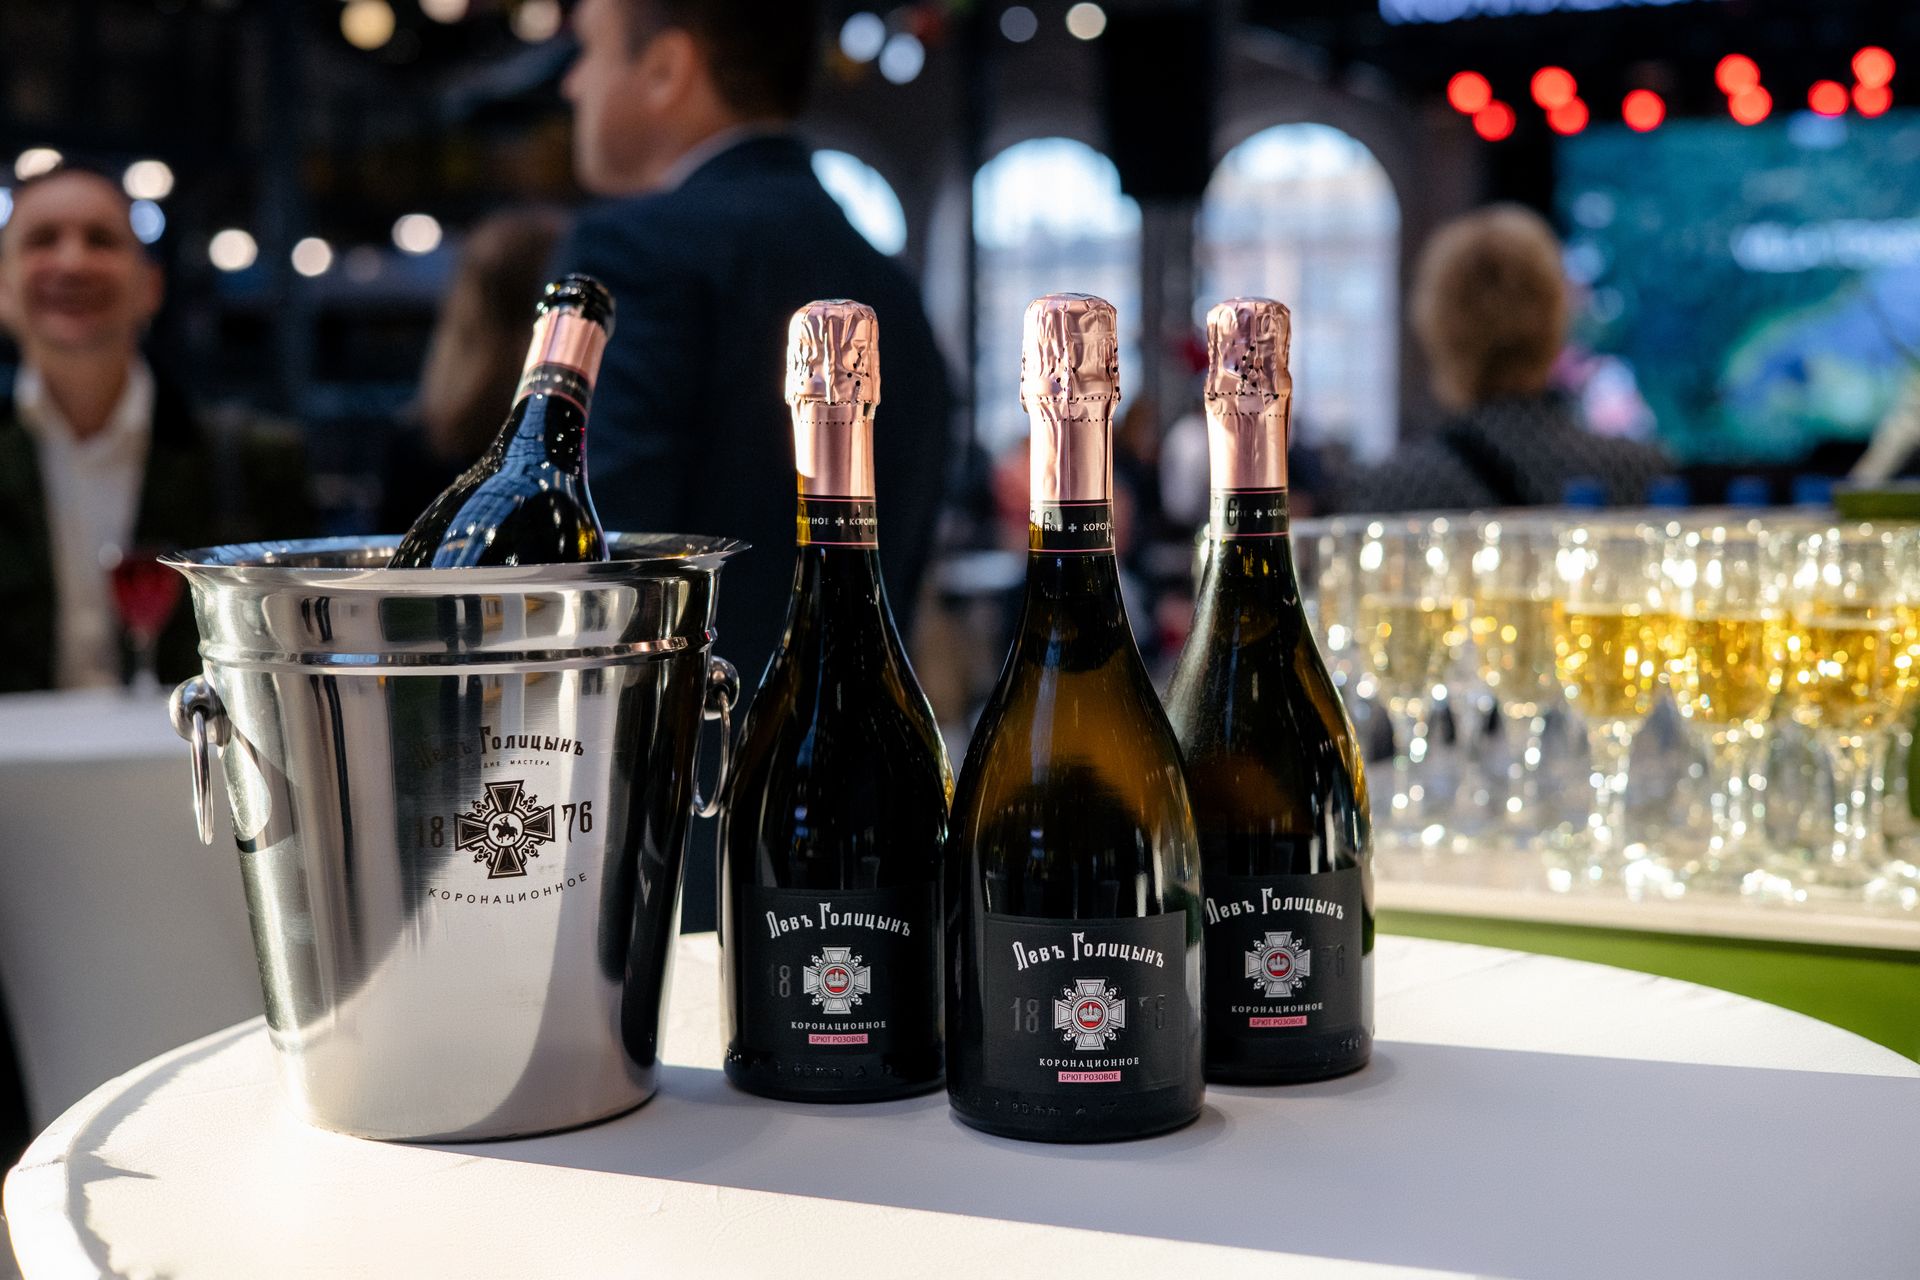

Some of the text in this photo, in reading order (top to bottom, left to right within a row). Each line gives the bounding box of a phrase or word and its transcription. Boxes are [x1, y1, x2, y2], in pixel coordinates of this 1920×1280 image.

[479, 726, 585, 756] Голицынъ
[510, 759, 550, 767] МАСТЕРА
[562, 800, 593, 843] 76
[428, 872, 587, 905] КОРОНАЦИОННОЕ
[1206, 887, 1344, 925] Левъ Голицынъ
[765, 902, 911, 939] Левъ Голицынъ
[1012, 931, 1164, 971] Левъ Голицынъ
[1010, 997, 1040, 1034] 18
[1231, 1002, 1323, 1014] КОРОНАЦИОННОЕ
[791, 1020, 887, 1031] КОРОНАЦИОННОЕ
[1252, 1017, 1305, 1026] БРЮТ РОЗОВОЕ
[811, 1034, 866, 1043] БРЮТ РОЗОВОЕ
[1039, 1056, 1140, 1068] КОРОНАЦИОННОЕ
[1061, 1072, 1118, 1081] БРЮТ РОЗОВОЕ
